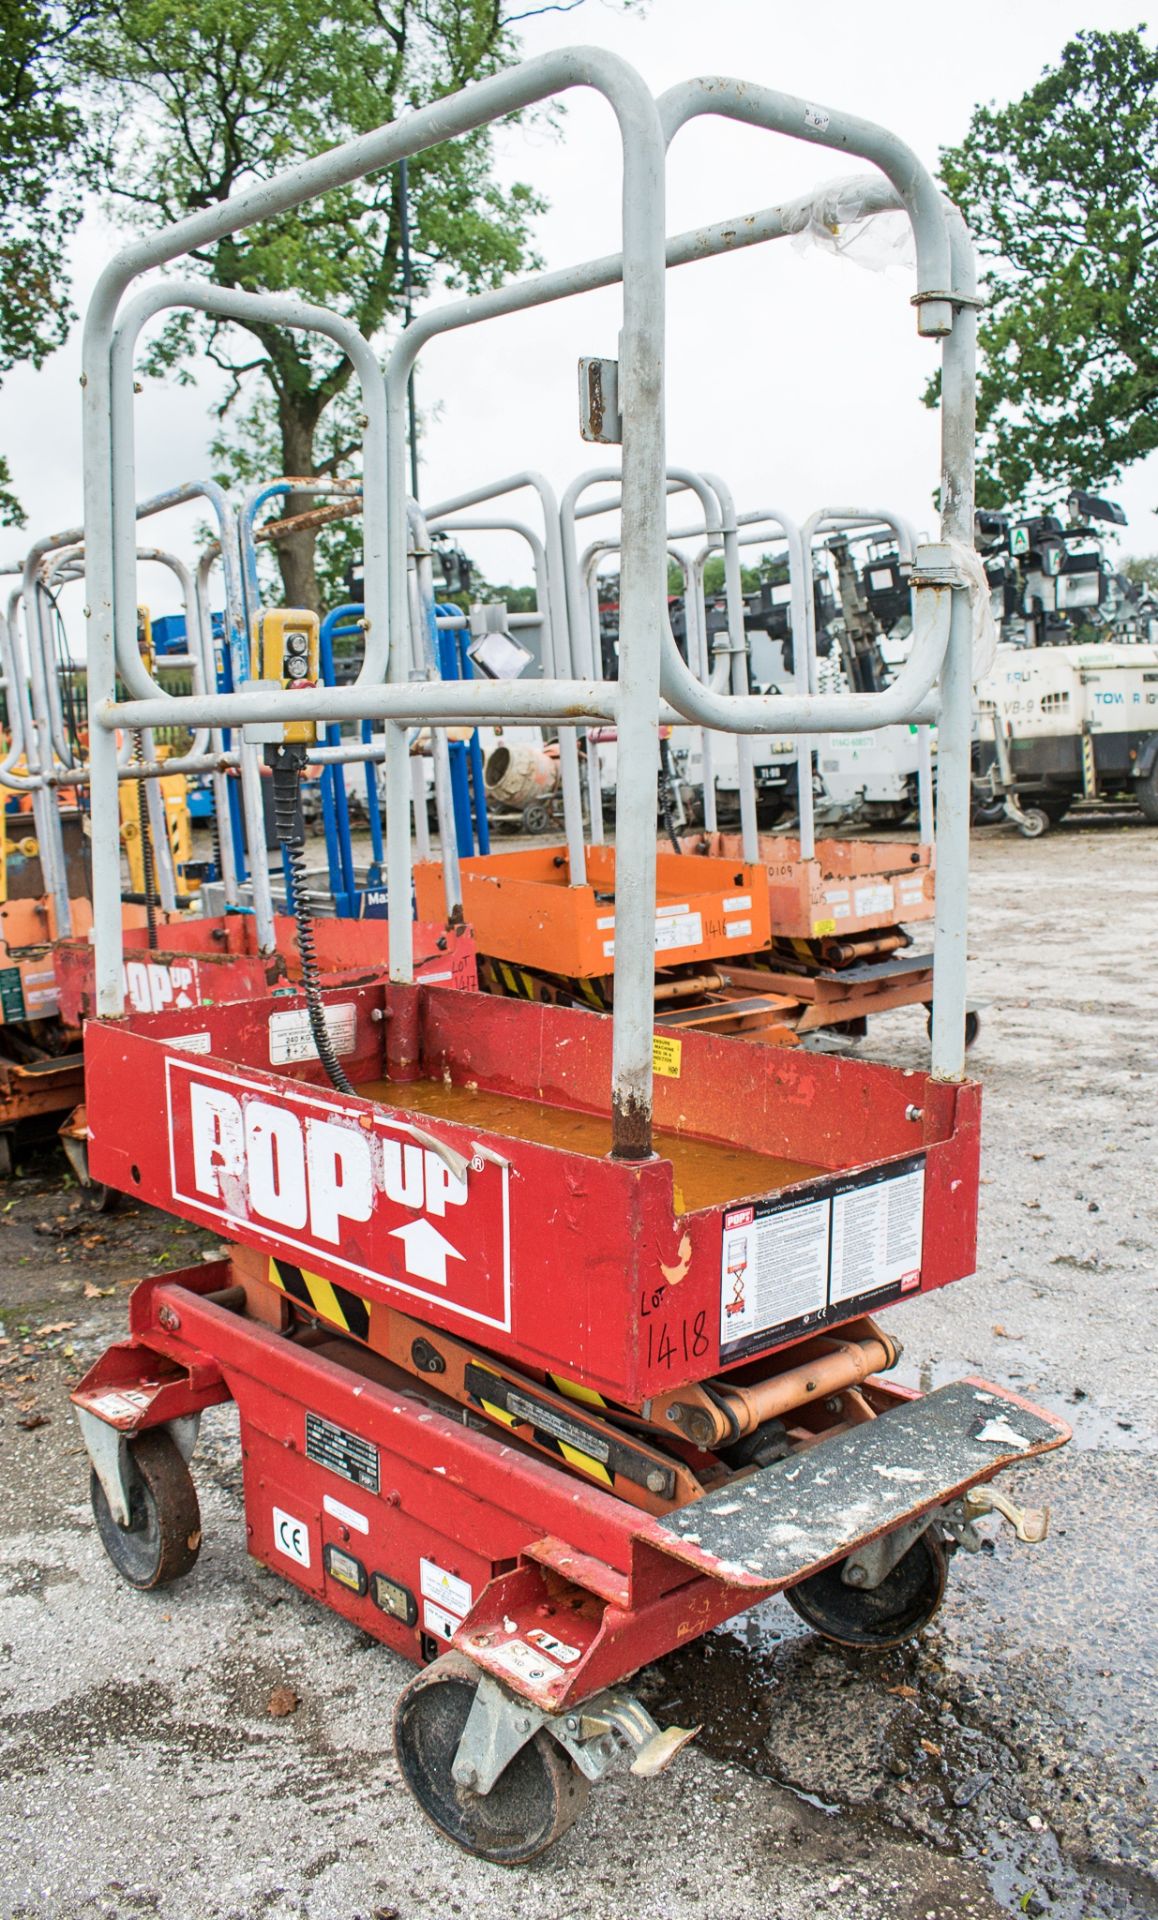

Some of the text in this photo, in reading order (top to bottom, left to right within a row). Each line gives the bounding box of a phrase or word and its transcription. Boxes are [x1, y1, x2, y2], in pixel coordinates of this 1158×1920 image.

[368, 891, 388, 905] Ma
[705, 919, 727, 938] 1416
[122, 961, 173, 1013] OP
[190, 1082, 373, 1246] POP
[382, 1138, 469, 1218] UP
[648, 1310, 709, 1370] 1418
[280, 1521, 302, 1556] CE
